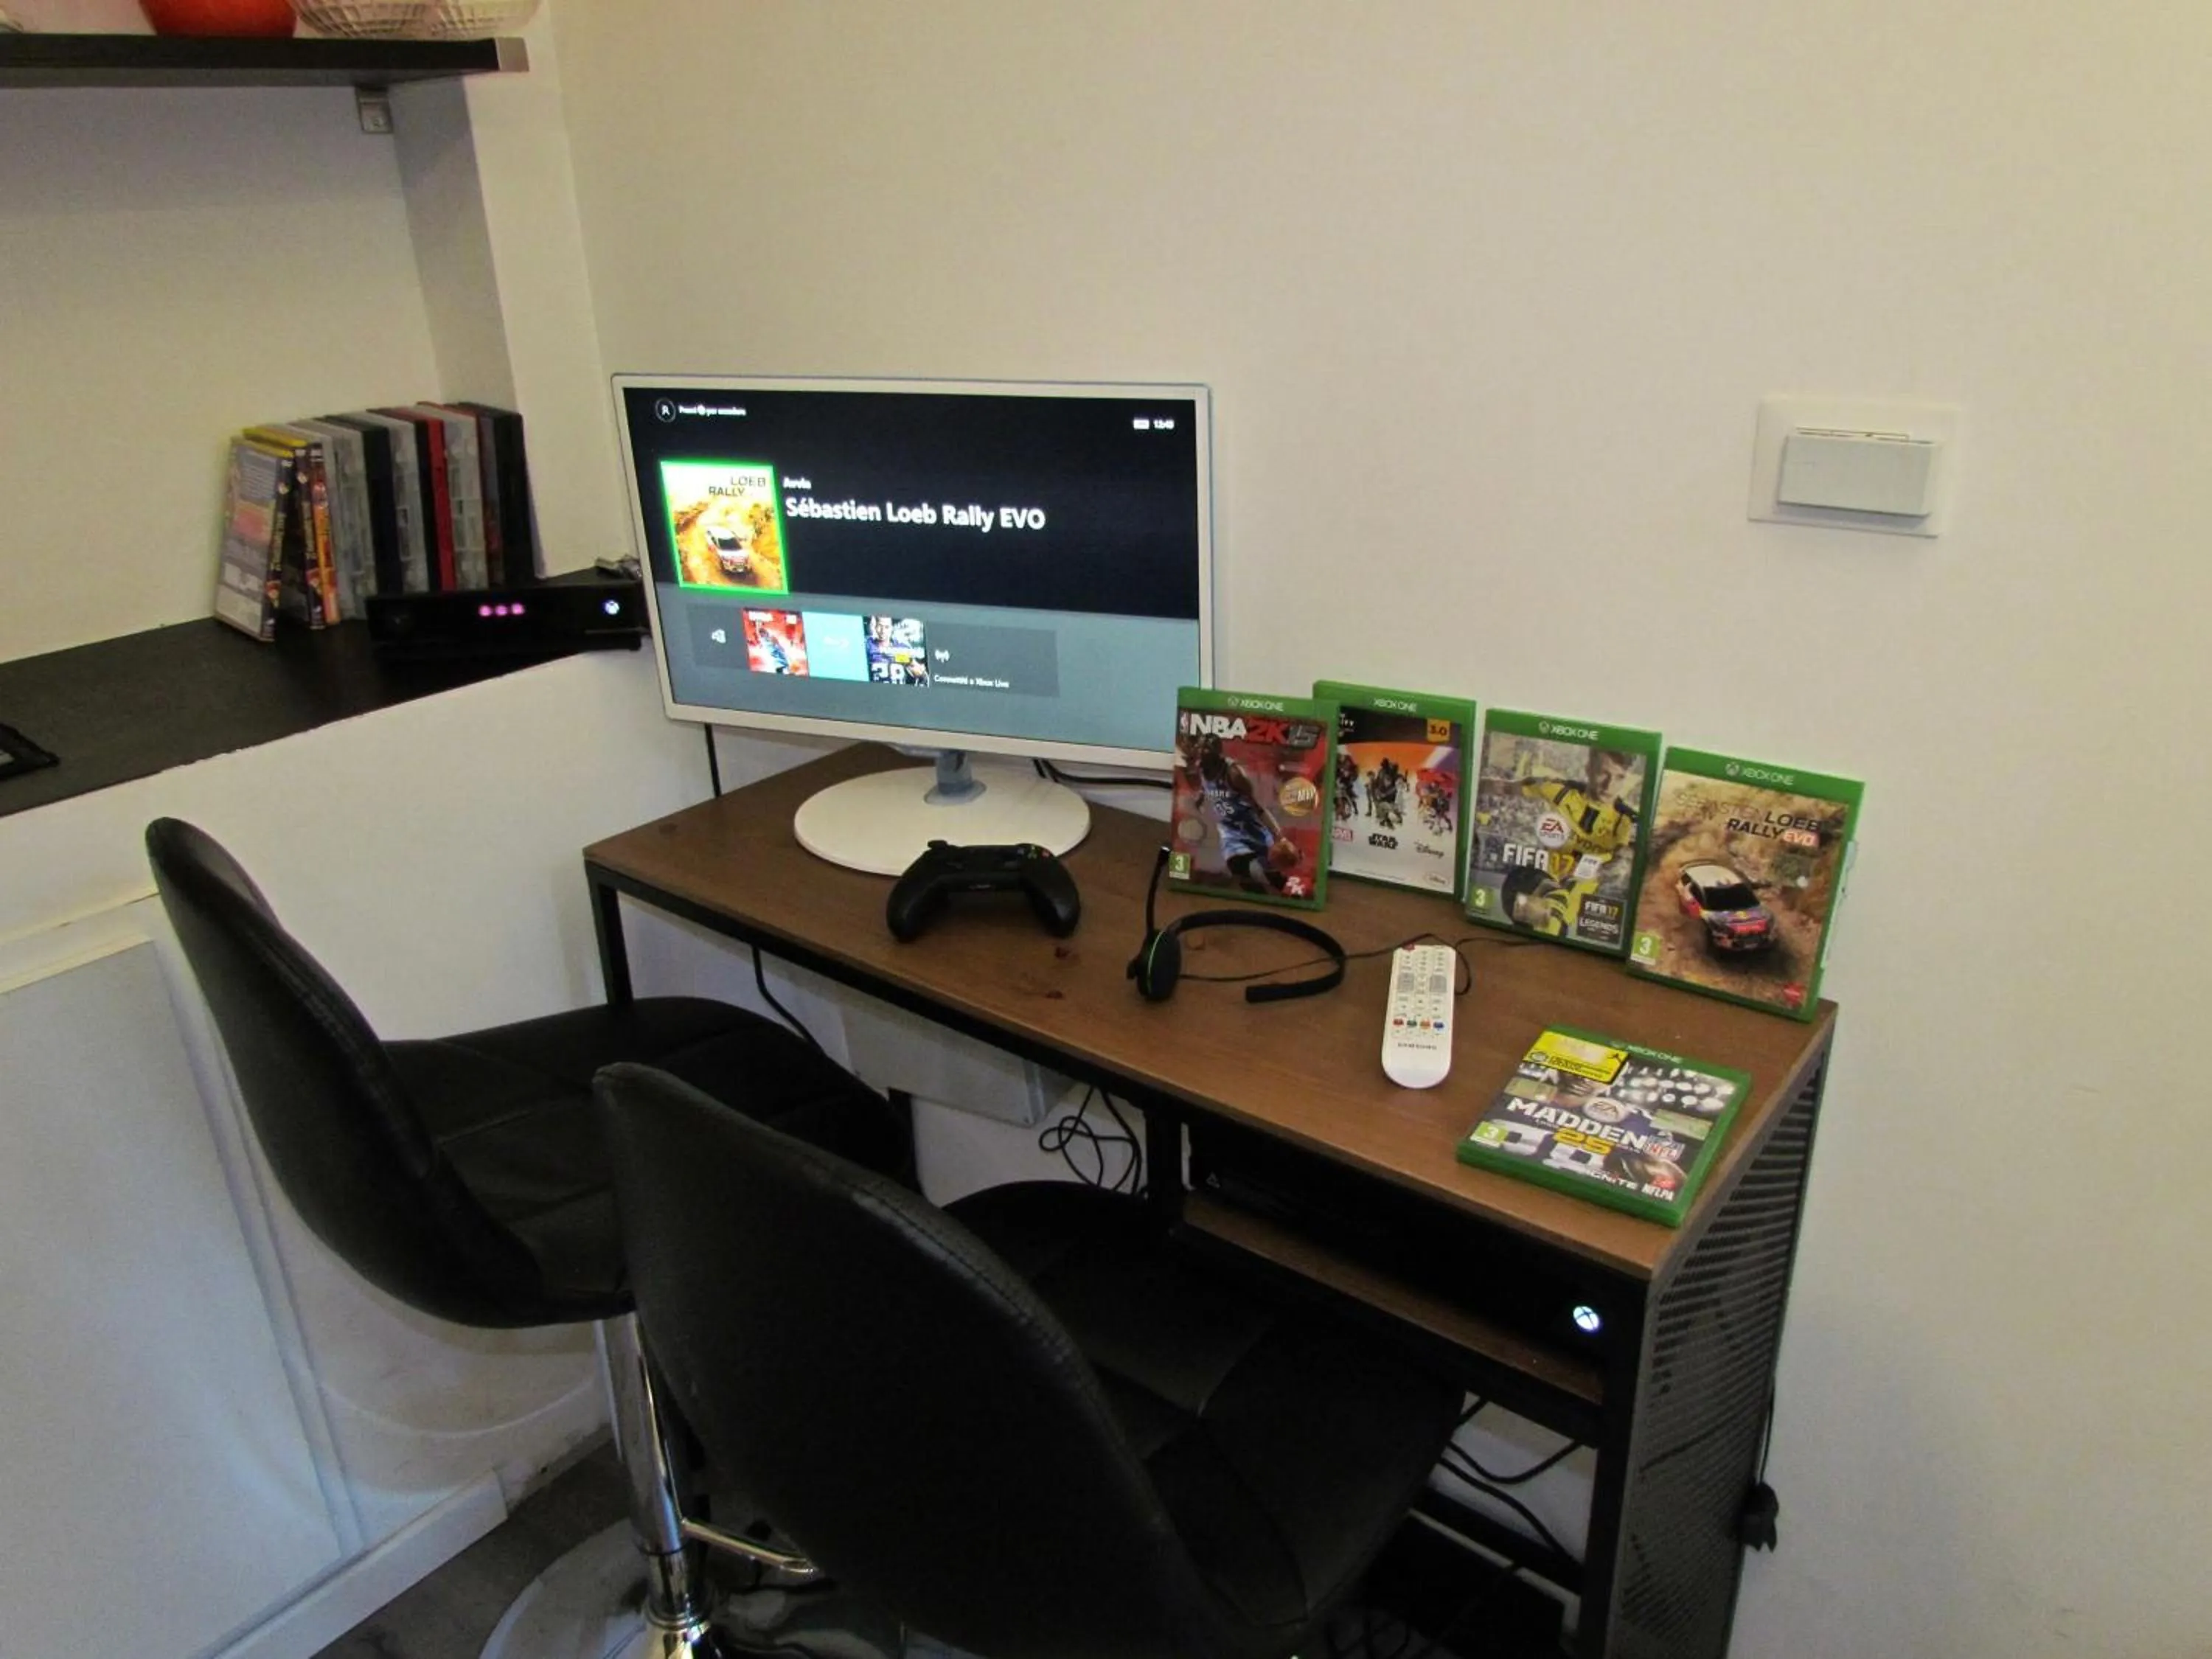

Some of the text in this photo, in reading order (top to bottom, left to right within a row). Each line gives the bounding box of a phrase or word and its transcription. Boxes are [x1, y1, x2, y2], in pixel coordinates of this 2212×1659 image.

[730, 476, 766, 487] LOEB
[709, 486, 745, 496] RALLY
[785, 497, 1046, 532] Sébastien Loeb Rally EVO
[1239, 700, 1284, 712] XBOX ONE
[1374, 699, 1417, 712] XBOX ONE
[1189, 713, 1247, 739] NBA
[1429, 724, 1447, 737] 3.0
[1551, 726, 1599, 740] XBOX ONE
[1742, 768, 1794, 785] XBOX ONE
[1540, 818, 1564, 833] EA
[1764, 811, 1820, 832] LOEB
[1727, 818, 1817, 846] RALLY EVO
[1175, 855, 1184, 872] 3
[1502, 843, 1548, 873] FIFA
[1550, 852, 1575, 875] 17
[1286, 876, 1305, 896] 2K
[1475, 889, 1486, 907] 3
[1585, 901, 1619, 917] FIFA 17
[1639, 936, 1652, 955] 3
[1627, 1044, 1685, 1064] XBOX ONE
[1507, 1097, 1648, 1151] MADDEN
[1484, 1126, 1500, 1140] 3
[1553, 1126, 1617, 1156] 25
